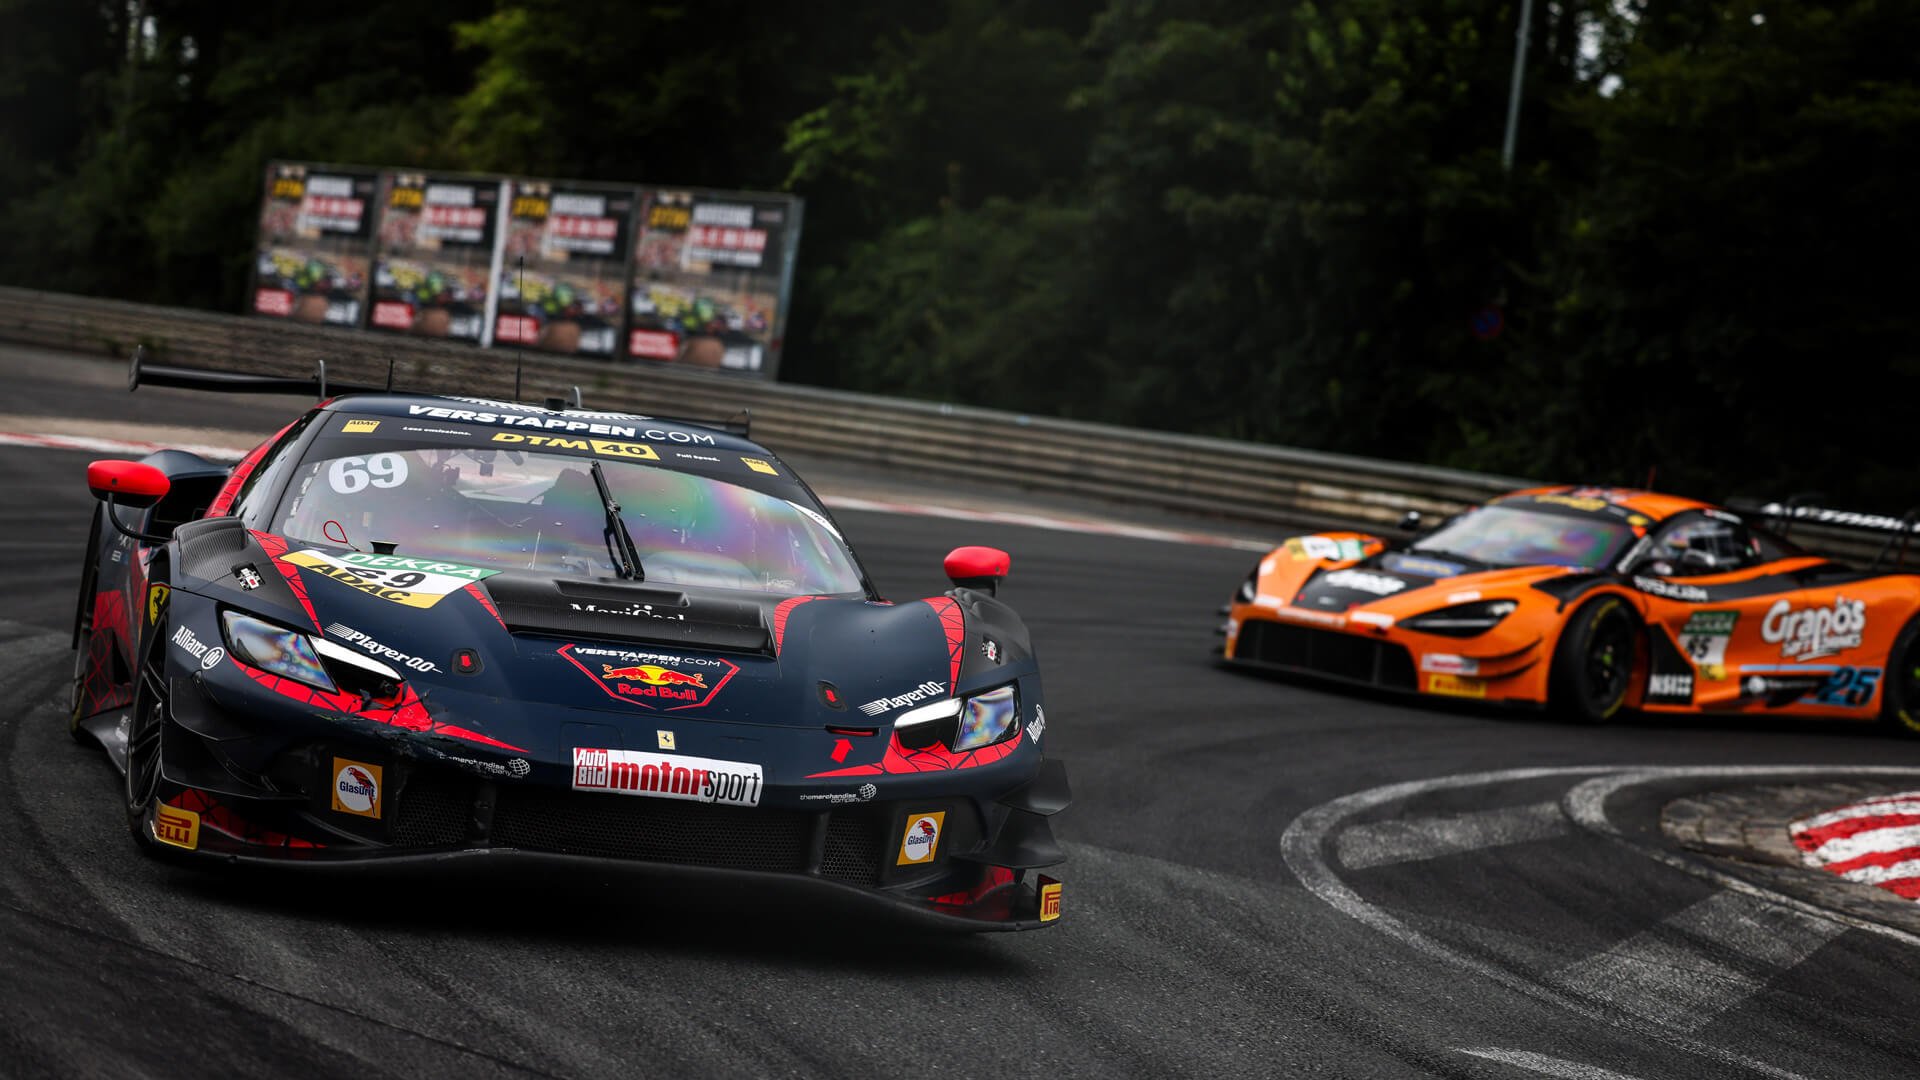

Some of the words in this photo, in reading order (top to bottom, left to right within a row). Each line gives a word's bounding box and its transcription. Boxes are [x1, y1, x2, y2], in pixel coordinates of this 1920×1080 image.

[349, 419, 378, 427] ADAC
[408, 404, 716, 446] VERSTAPPEN.COM
[491, 432, 590, 451] DTM
[600, 443, 648, 457] 40
[328, 452, 409, 495] 69
[338, 552, 483, 580] DEKRA
[307, 563, 411, 602] ADAC
[171, 624, 209, 660] Allianz
[574, 647, 721, 668] VERSTAPPEN.COM
[620, 656, 680, 668] RACING
[617, 682, 658, 698] Red
[659, 687, 698, 702] Bull
[1815, 664, 1884, 709] 25
[577, 749, 607, 767] Auto
[577, 766, 607, 786] Bild
[609, 761, 761, 804] motorsport
[339, 780, 376, 798] Glasurit
[1043, 890, 1060, 916] PIR
